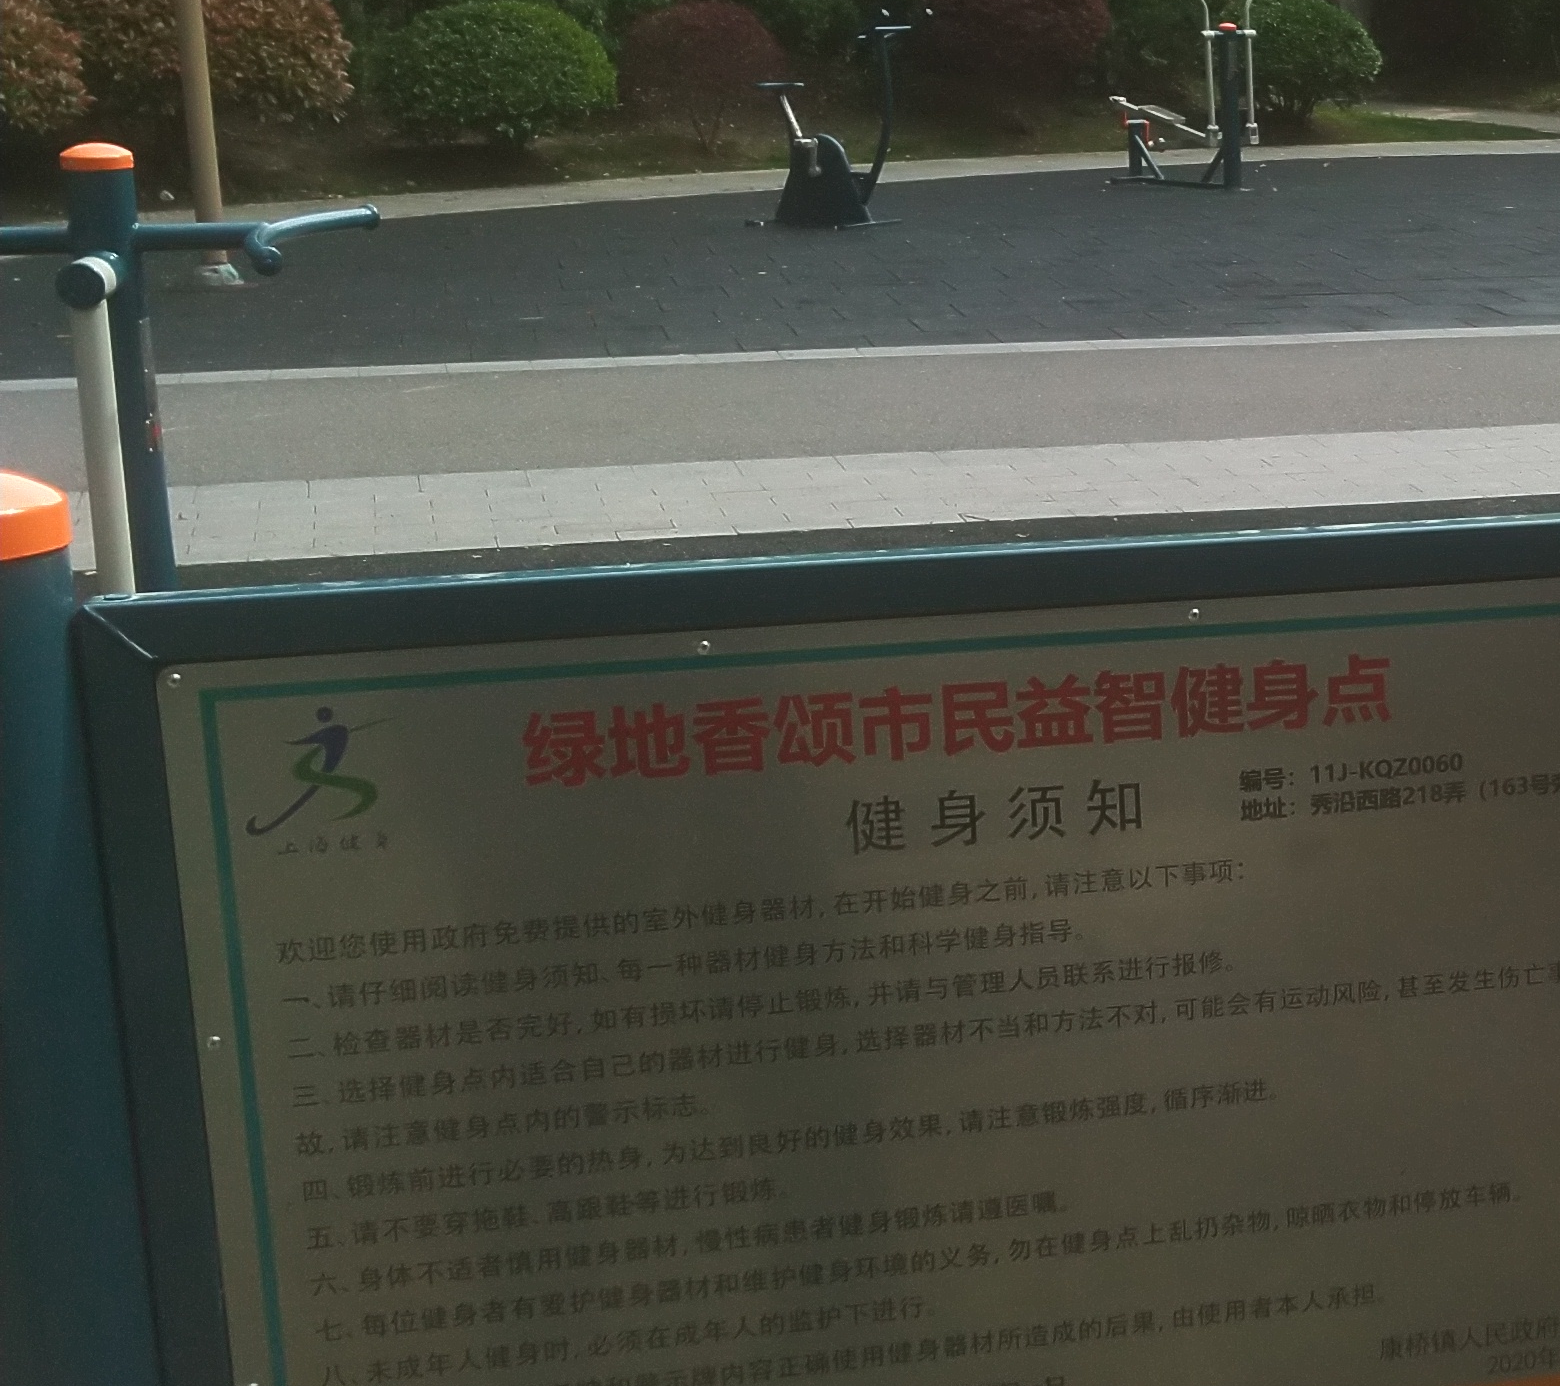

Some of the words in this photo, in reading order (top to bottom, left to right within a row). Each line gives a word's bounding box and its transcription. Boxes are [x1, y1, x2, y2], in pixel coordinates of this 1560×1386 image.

[520, 649, 1393, 790] 绿地香颂市民益智健身点
[844, 774, 1144, 856] 健身须知
